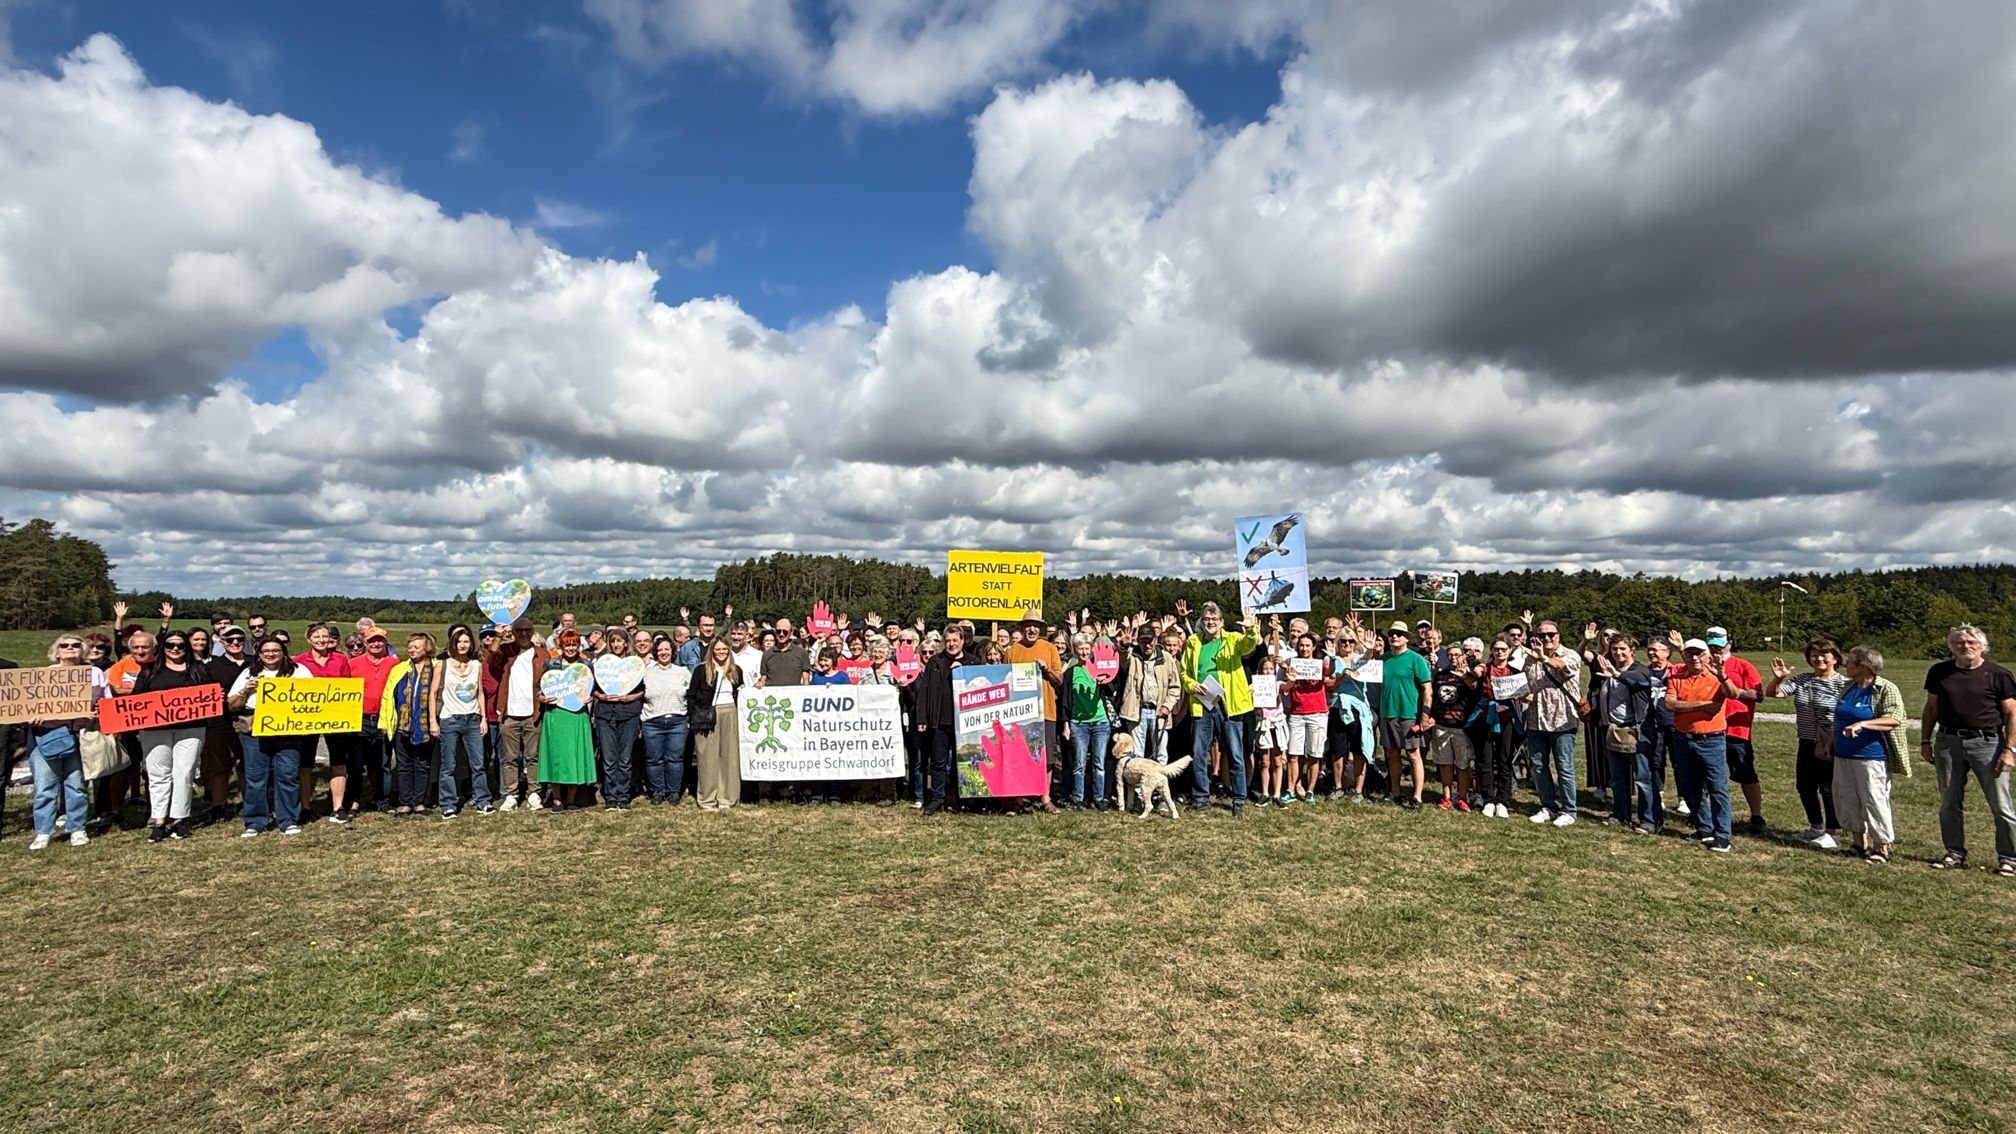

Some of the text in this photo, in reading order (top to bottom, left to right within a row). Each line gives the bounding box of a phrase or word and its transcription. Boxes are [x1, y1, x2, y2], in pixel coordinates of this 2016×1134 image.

[949, 562, 1042, 576] ARTENVIELFALT
[982, 581, 1012, 591] STATT
[948, 596, 1041, 610] ROTORENLÄRM
[20, 669, 45, 685] FÜR
[49, 668, 92, 685] REICHE
[262, 682, 362, 704] Rotorenlärm
[961, 687, 1006, 707] HÄNDE WEG
[0, 700, 90, 717] FÜR WEN SONST
[115, 699, 153, 714] Hier
[291, 705, 323, 714] tötet
[801, 697, 855, 713] BUND
[125, 703, 217, 727] ihr NICHT!
[964, 703, 1034, 728] VON DER NATUR!
[803, 717, 892, 732] Naturschutz
[803, 736, 894, 754] in Bayern e.V.
[749, 755, 896, 773] Kreisgruppe Schwandorf
